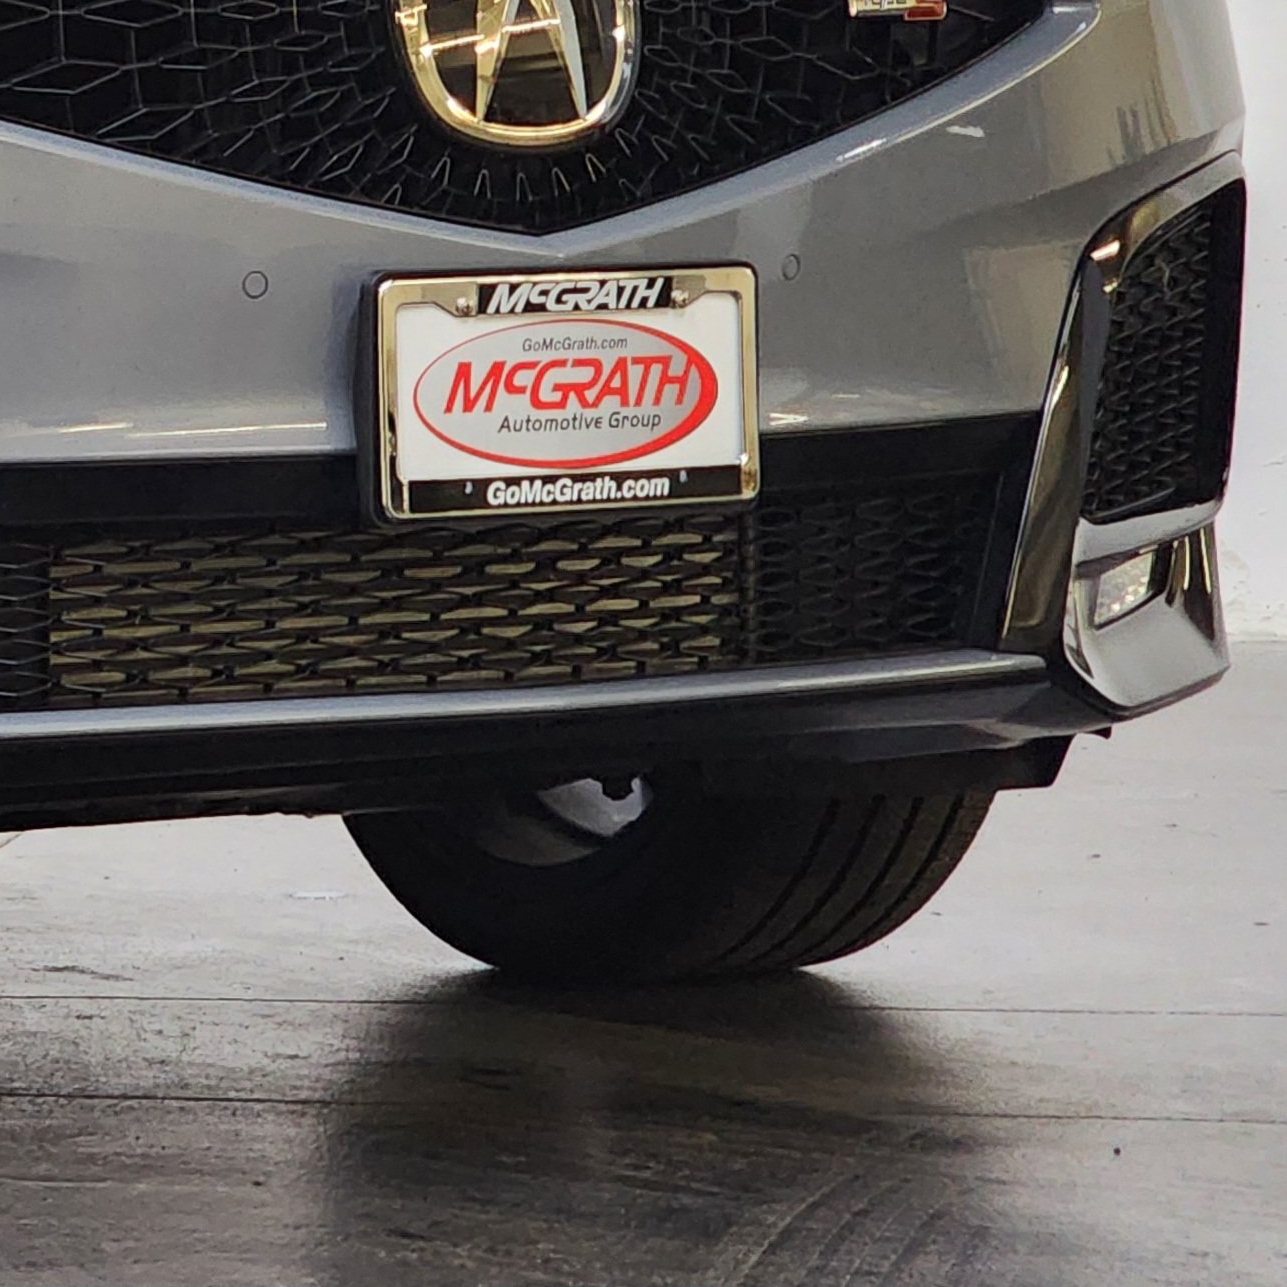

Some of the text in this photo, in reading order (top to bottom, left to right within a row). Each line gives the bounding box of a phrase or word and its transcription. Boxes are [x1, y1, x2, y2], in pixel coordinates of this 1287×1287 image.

[521, 335, 629, 353] GoMcGrath.com
[497, 411, 663, 434] Automotive Group
[485, 474, 671, 507] GoMcGrath.com
